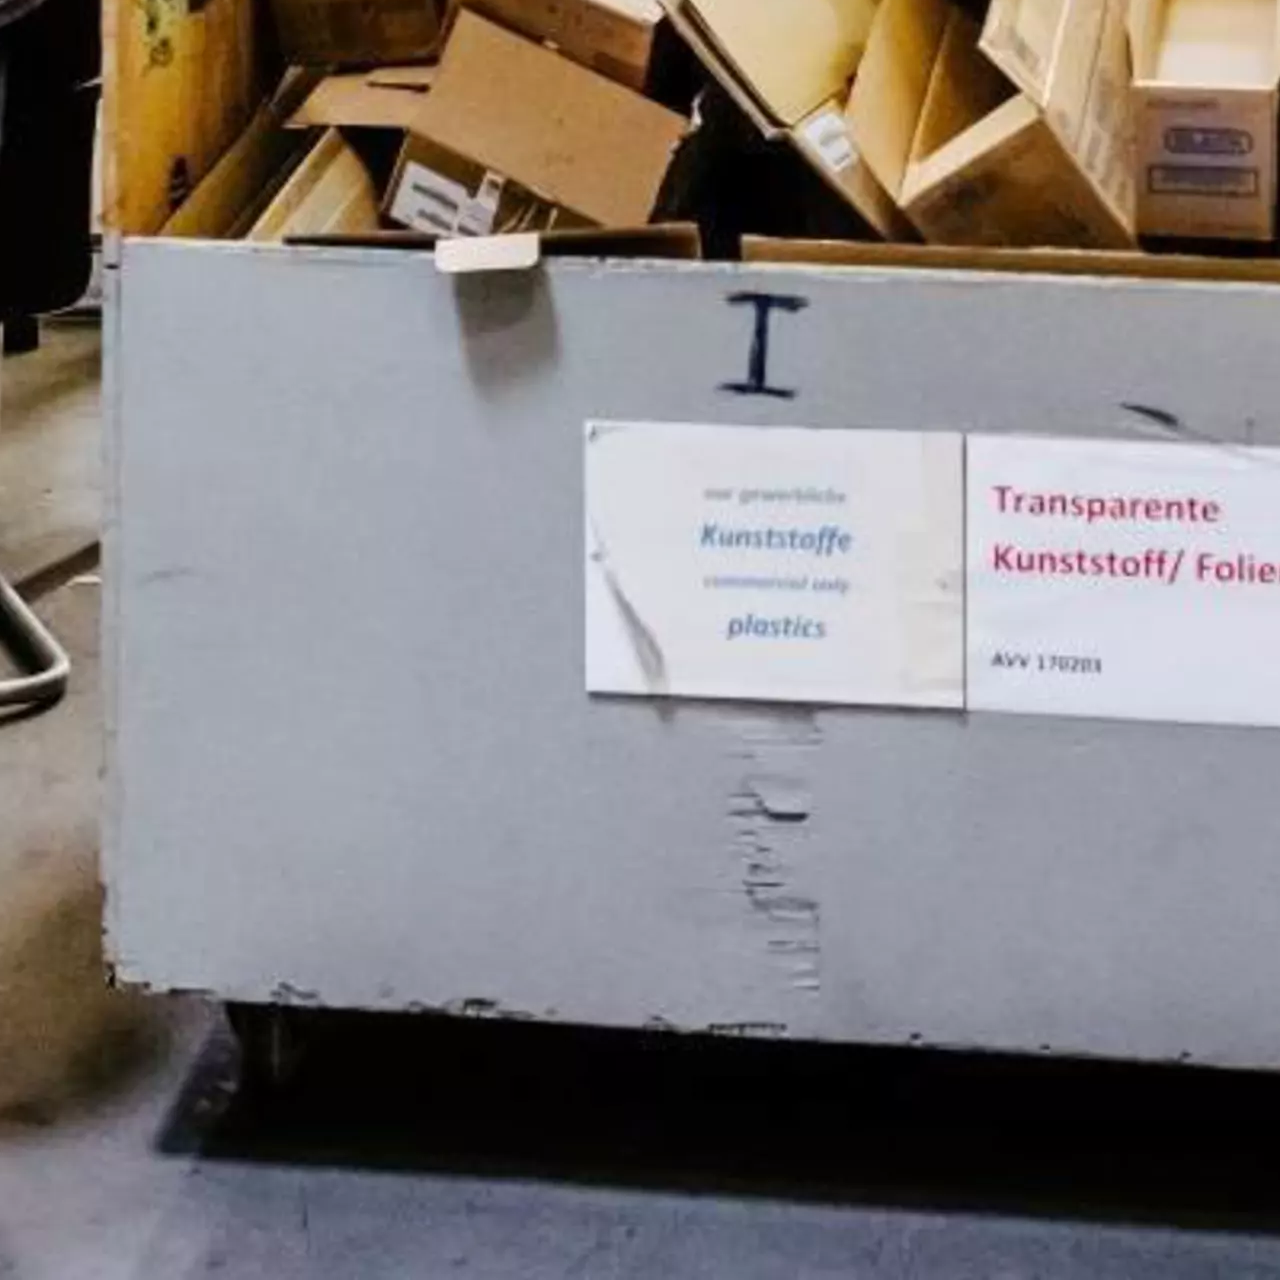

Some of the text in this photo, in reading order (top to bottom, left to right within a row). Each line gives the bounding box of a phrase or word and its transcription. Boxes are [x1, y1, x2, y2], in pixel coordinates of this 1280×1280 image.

[717, 291, 810, 401] I
[993, 485, 1221, 523] Transparente
[699, 521, 853, 556] Kunststoffe
[993, 545, 1186, 585] Kunststoff/
[725, 614, 827, 640] plastics
[990, 651, 1031, 668] AVV
